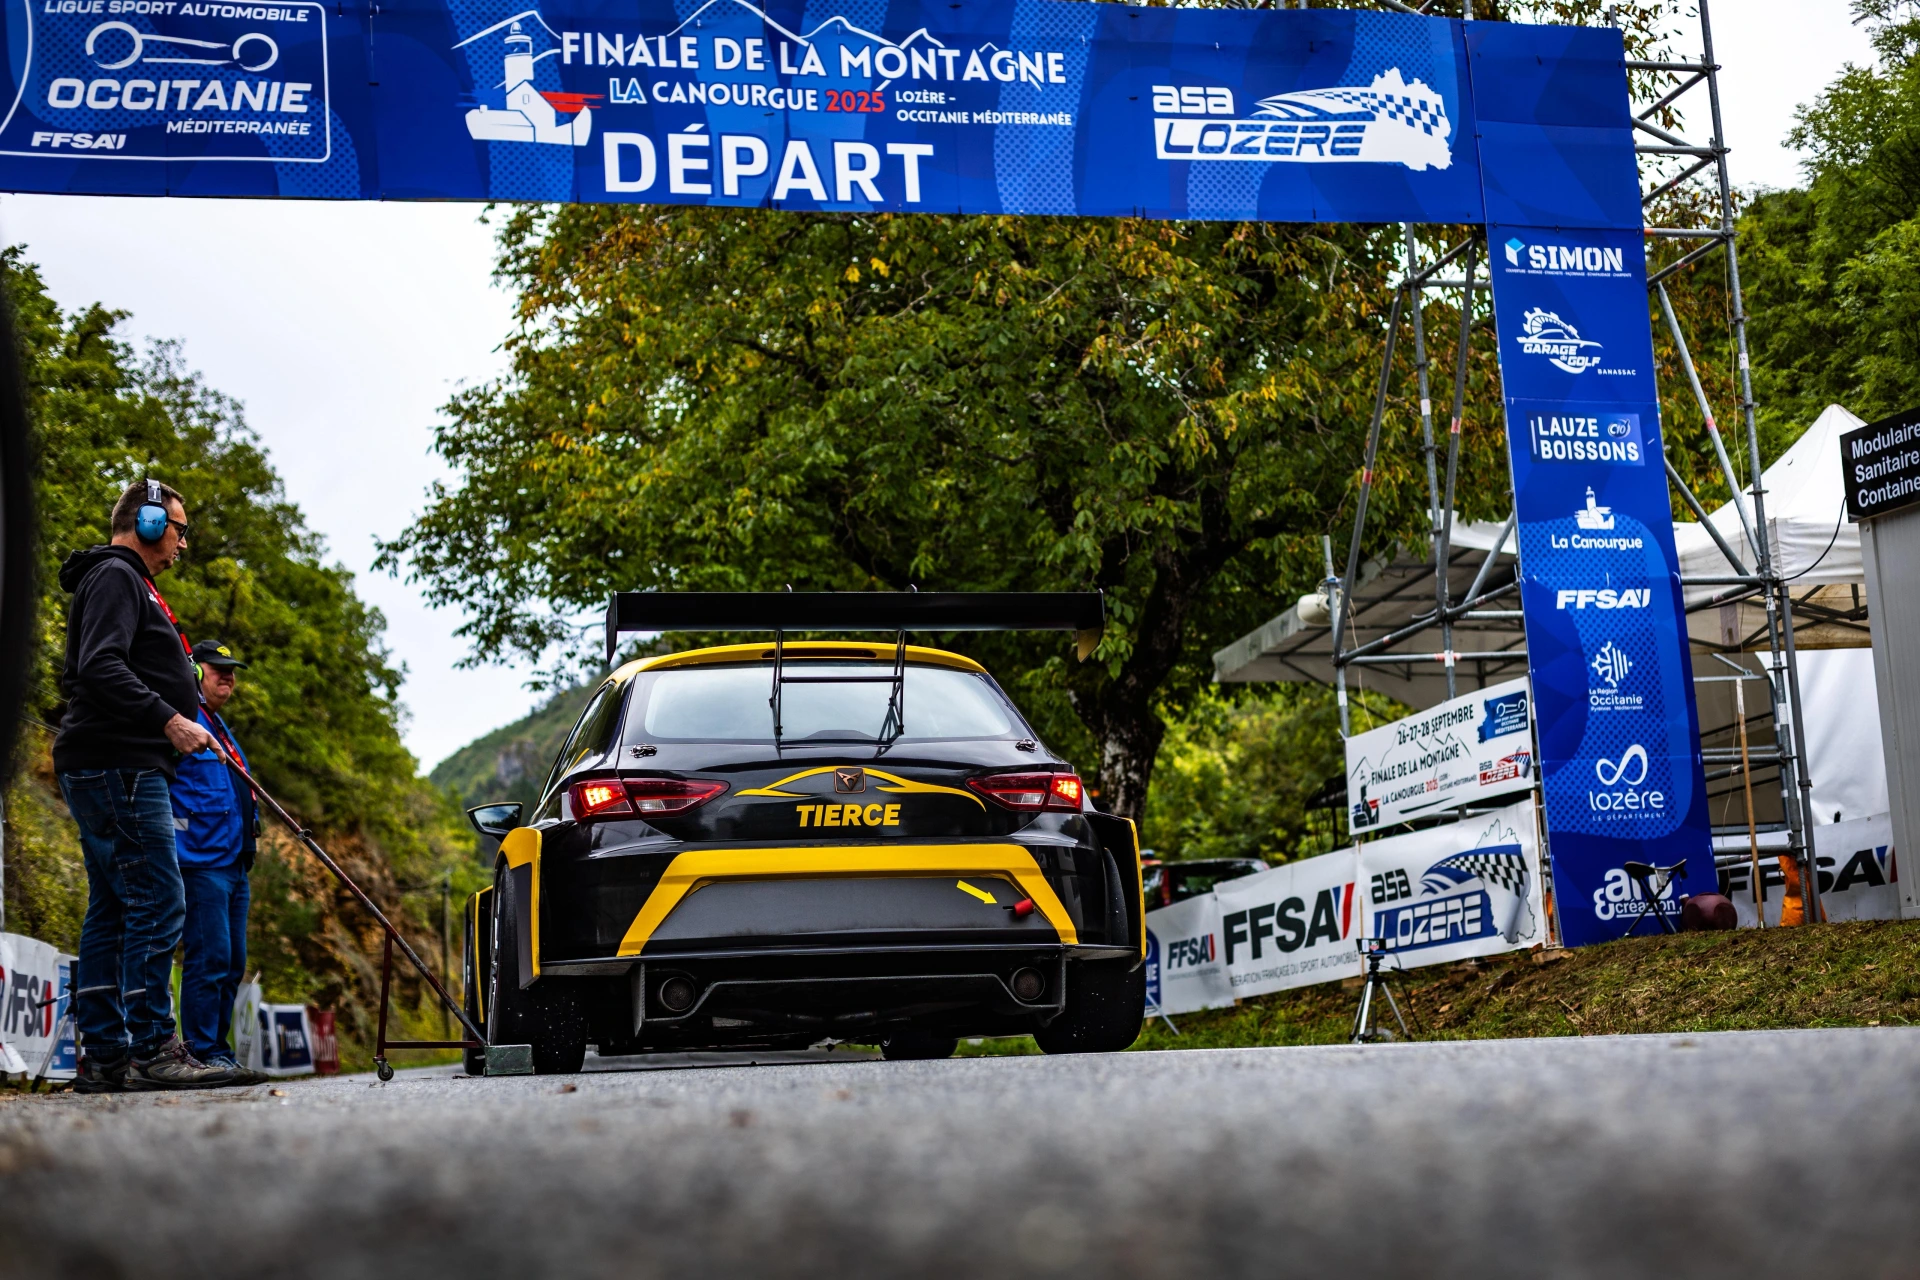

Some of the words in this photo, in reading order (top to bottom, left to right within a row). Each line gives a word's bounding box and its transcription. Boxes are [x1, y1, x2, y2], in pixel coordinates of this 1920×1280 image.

[45, 0, 103, 13] LIGUE
[108, 1, 176, 15] SPORT
[179, 4, 309, 22] AUTOMOBILE
[562, 31, 699, 69] FINALE
[714, 37, 765, 71] DE
[780, 41, 827, 76] LA
[840, 44, 1066, 84] MONTAGNE
[47, 78, 312, 113] OCCITANIE
[609, 77, 648, 104] LA
[652, 81, 818, 111] CANOURGUE
[825, 90, 885, 113] 2025
[895, 88, 946, 104] LOZÈRE
[1152, 85, 1235, 115] asa
[166, 118, 311, 135] MÉDITERRANÉE
[896, 109, 969, 124] OCCITANIE
[973, 111, 1072, 126] MÉDITERRANÉE
[31, 131, 126, 150] FFSA
[1163, 122, 1366, 156] LOZERE
[603, 123, 934, 203] DÉPART
[1528, 245, 1623, 272] SIMON
[1523, 343, 1578, 355] GARAGE
[1567, 356, 1601, 367] GOLF
[1597, 368, 1637, 376] BANASSAC
[1537, 416, 1600, 438] LAUZE
[1540, 440, 1640, 462] BOISSONS
[1852, 422, 1920, 460] Modulaire
[1551, 534, 1569, 549] La
[1571, 534, 1643, 551] Canourgue
[1556, 588, 1651, 610] FFSA
[1590, 694, 1643, 706] Occitanie
[1397, 721, 1430, 746] 26-27-28
[1431, 704, 1474, 734] SEPTEMBRE
[1371, 765, 1396, 786] FINALE
[1397, 761, 1407, 778] DE
[1408, 759, 1418, 774] LA
[1419, 743, 1460, 771] MONTAGNE
[1480, 765, 1516, 784] LOZERE
[1381, 793, 1390, 805] LA
[1390, 782, 1425, 802] CANOURGUE
[1425, 778, 1439, 793] 2025
[1589, 788, 1664, 811] lozère
[796, 803, 901, 827] TIERCE
[1607, 812, 1666, 821] DÉPARTEMENT
[1371, 868, 1412, 904] asa
[1223, 886, 1350, 965] FFSA
[1378, 894, 1482, 951] LOZERE
[1167, 933, 1213, 969] FFSA
[1300, 958, 1319, 973] SPORT
[1320, 951, 1358, 967] AUTOMOBILE
